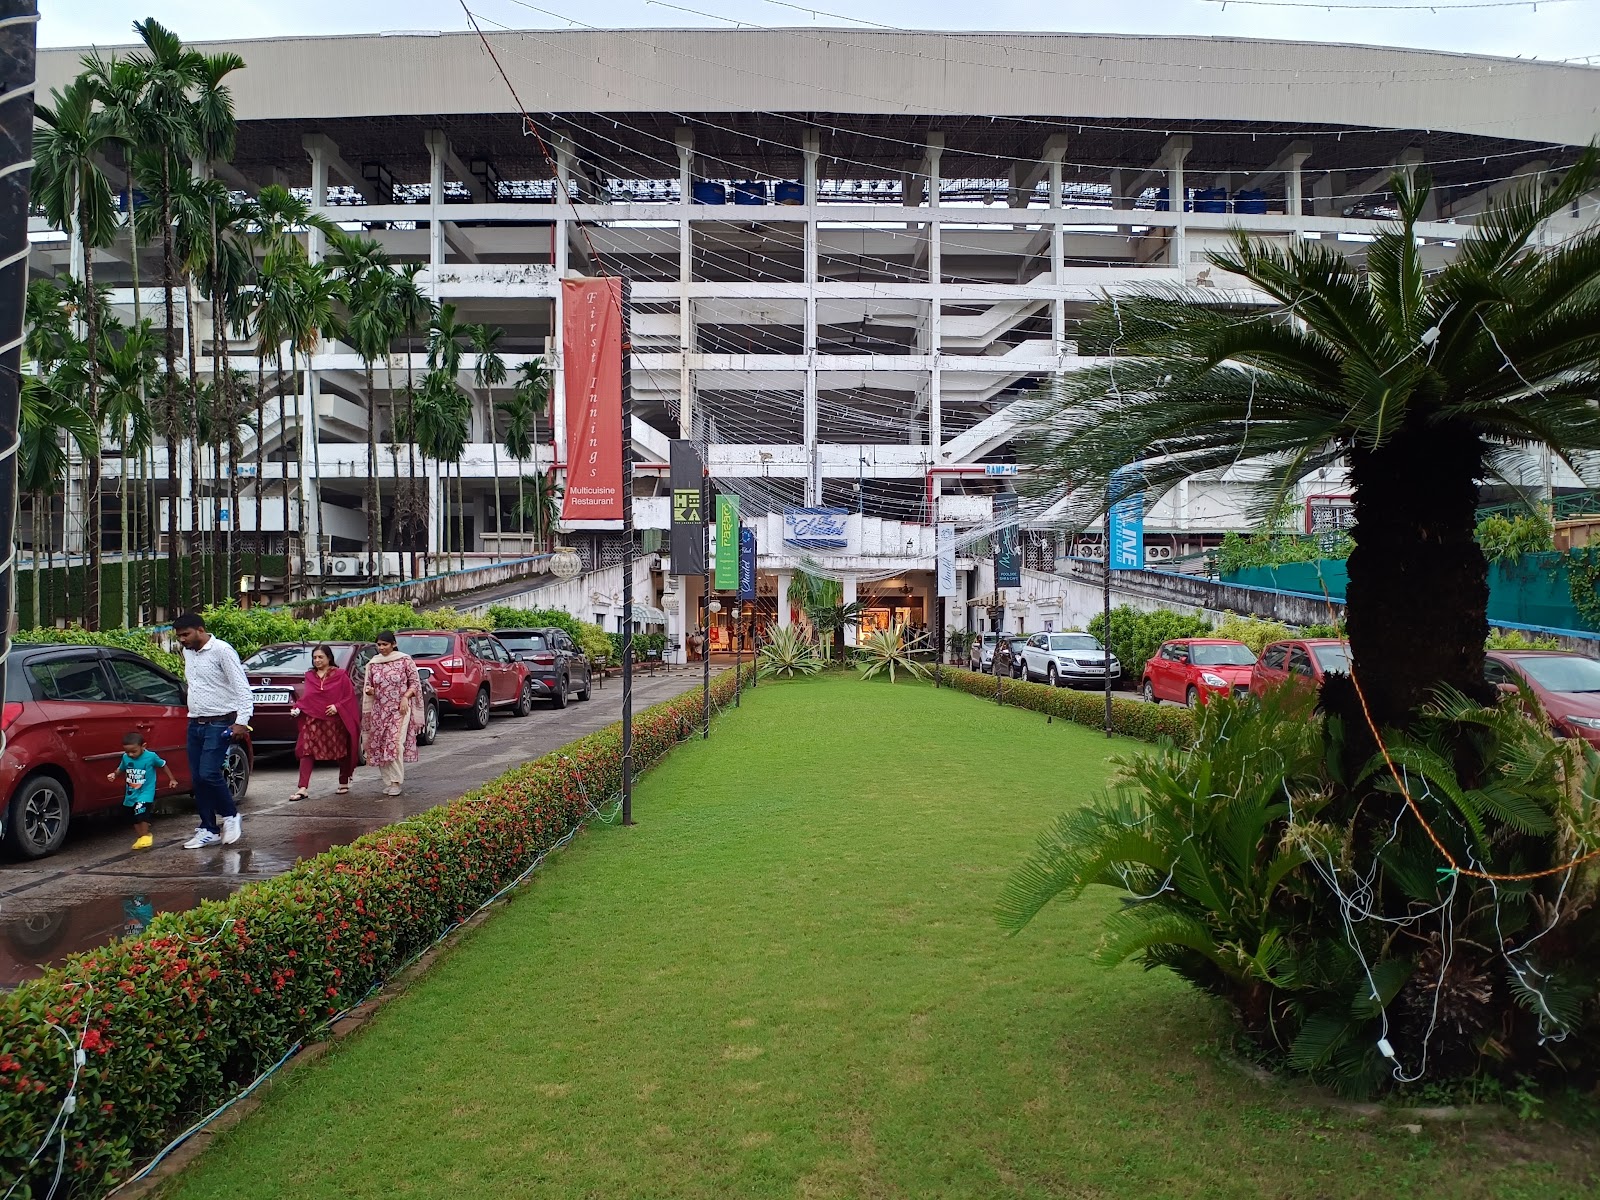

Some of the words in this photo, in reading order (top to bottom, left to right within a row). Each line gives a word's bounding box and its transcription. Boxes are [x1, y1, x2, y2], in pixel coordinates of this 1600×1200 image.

[586, 292, 598, 363] First
[588, 377, 598, 477] Innings
[570, 486, 616, 495] Multicuisine
[571, 497, 614, 505] Restaurant
[1115, 538, 1123, 563] CLUB
